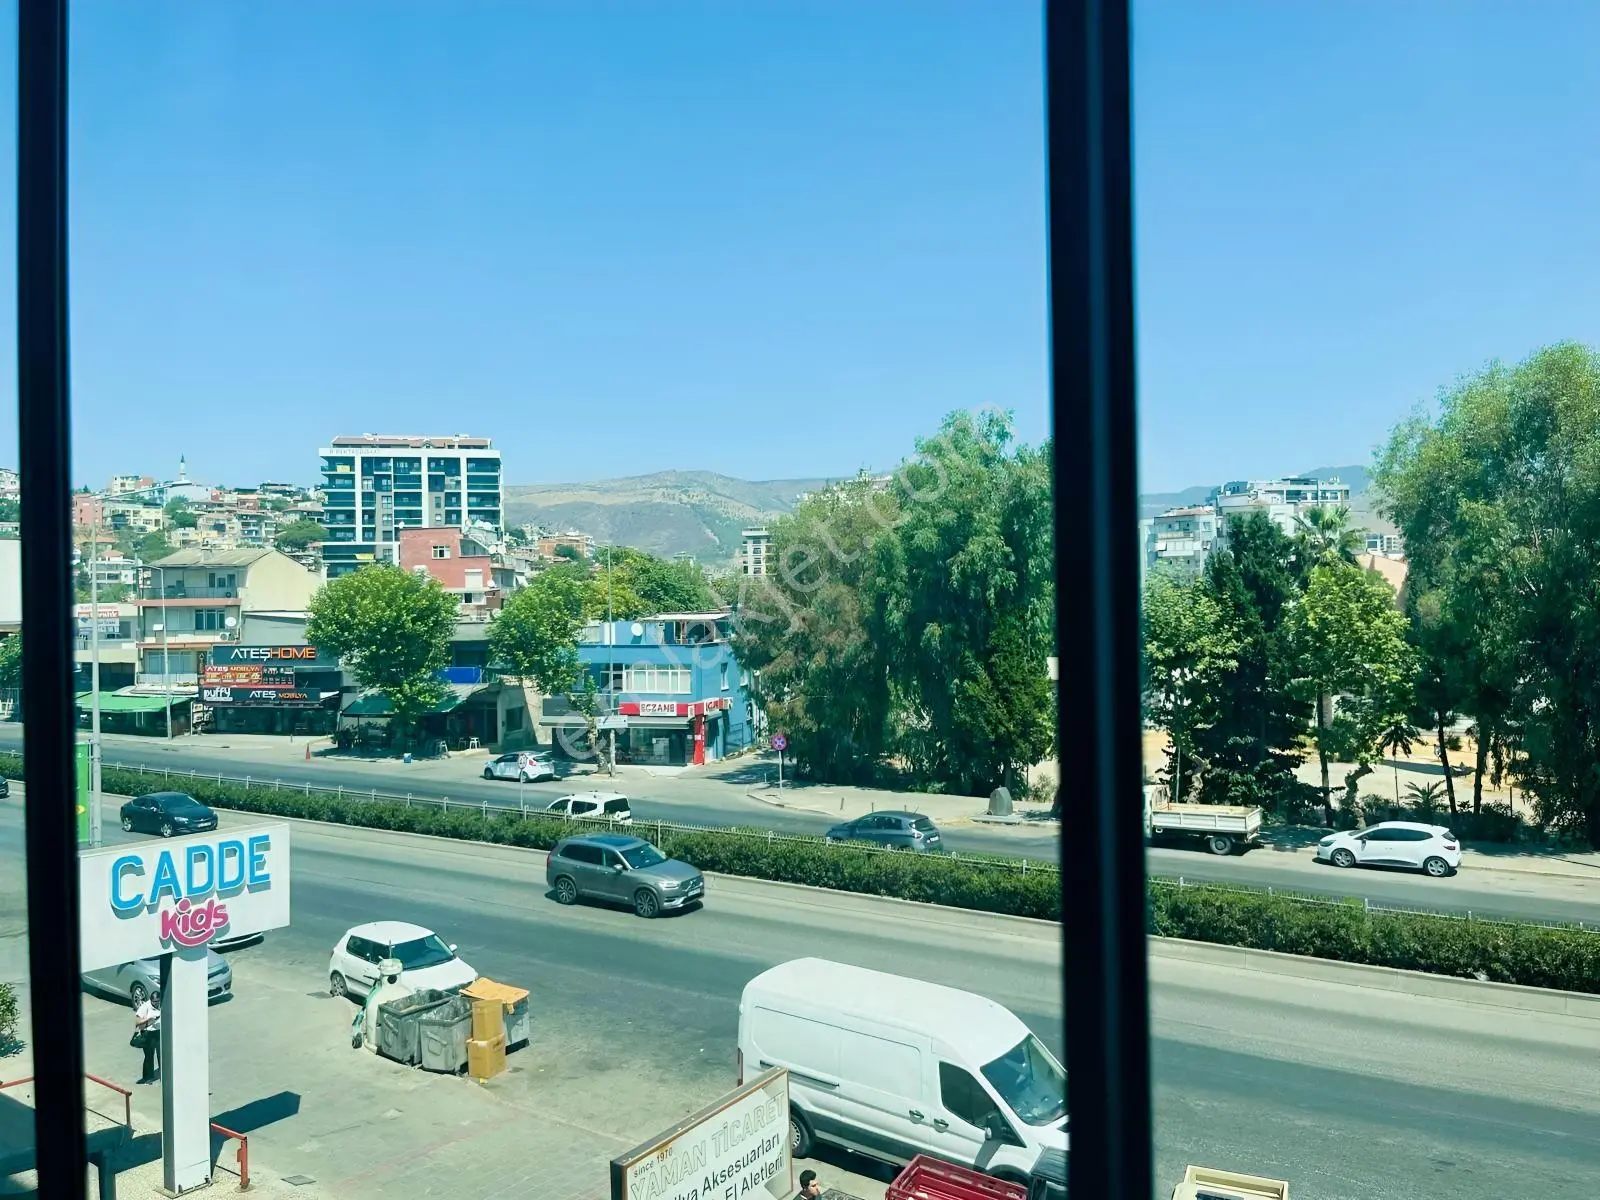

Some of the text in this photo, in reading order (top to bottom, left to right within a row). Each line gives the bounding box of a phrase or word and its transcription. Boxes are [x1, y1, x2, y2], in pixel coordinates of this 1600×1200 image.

[249, 690, 276, 700] ATEŞ
[110, 834, 271, 912] CADDE
[160, 897, 229, 947] Kids
[630, 1092, 785, 1200] YAMAN TİCARET
[633, 1160, 654, 1178] since
[702, 1132, 780, 1197] Aksesuarları
